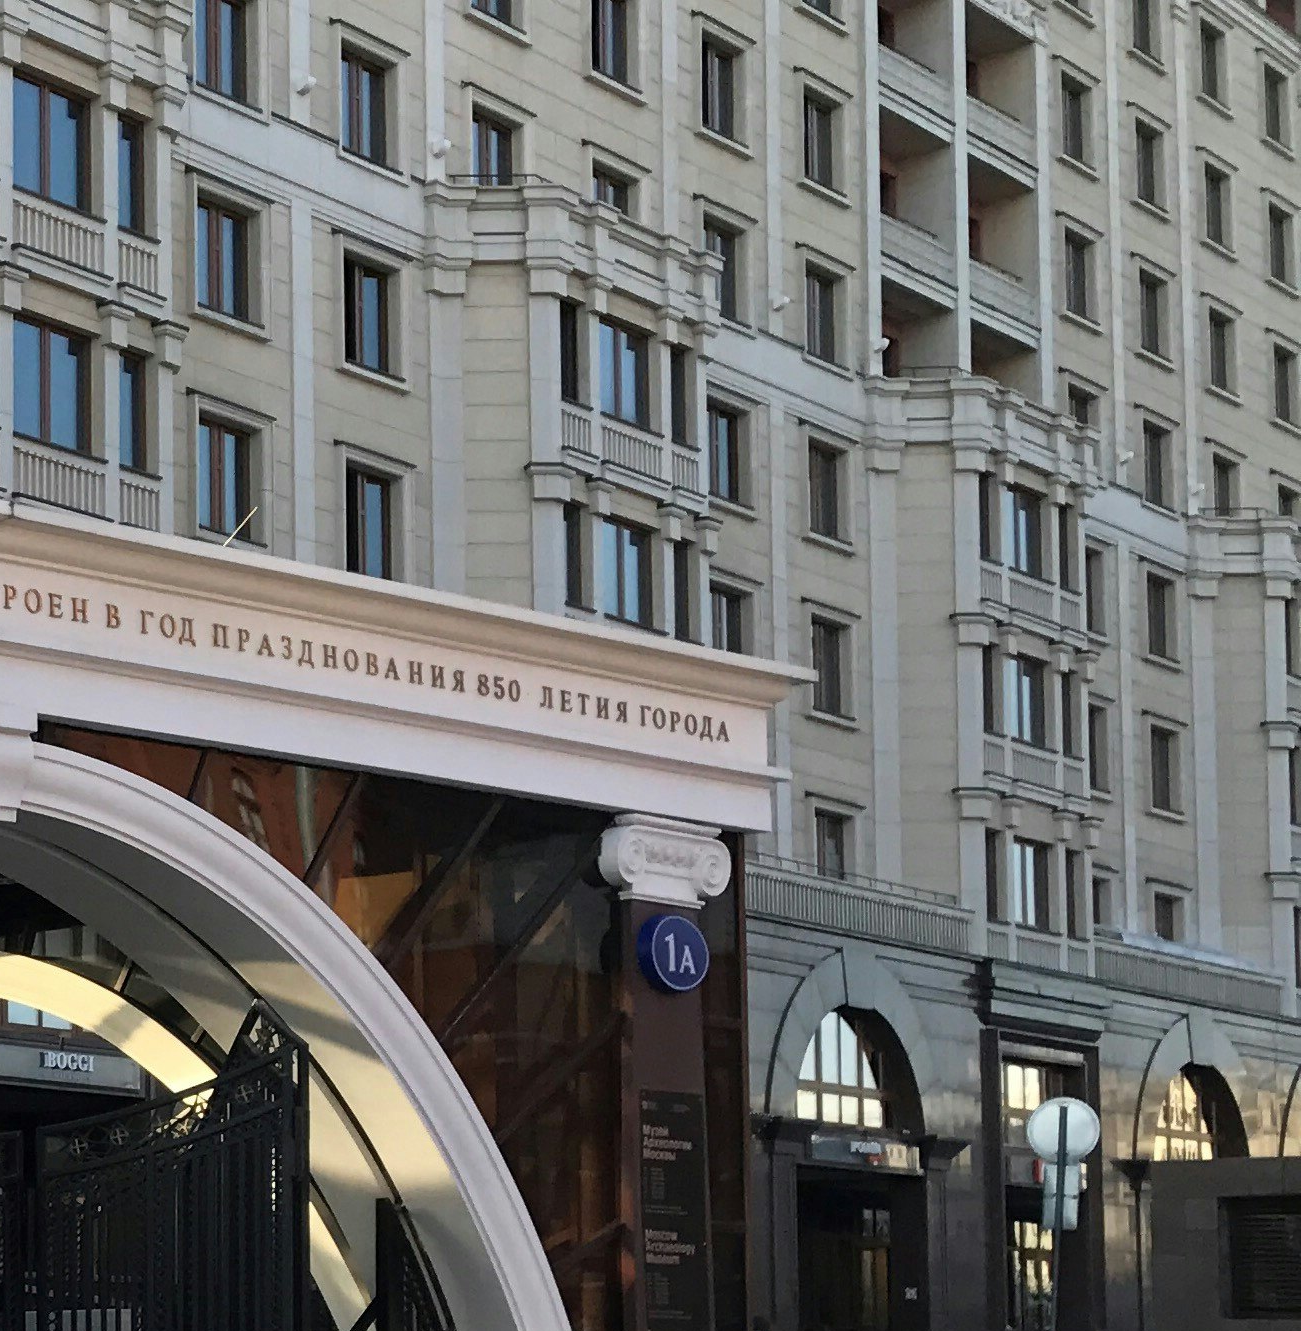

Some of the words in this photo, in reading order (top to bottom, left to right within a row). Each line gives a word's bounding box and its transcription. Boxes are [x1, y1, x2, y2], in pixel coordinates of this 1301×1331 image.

[104, 603, 122, 630] В
[139, 609, 197, 648] ГОД
[211, 622, 466, 694] ПРАЗДНОВАНИЯ
[476, 673, 521, 703] 850
[539, 685, 628, 724] ЛЕТИЯ
[638, 704, 731, 743] ГОРОДА
[663, 932, 696, 975] 1А
[43, 1051, 95, 1072] BOGGI
